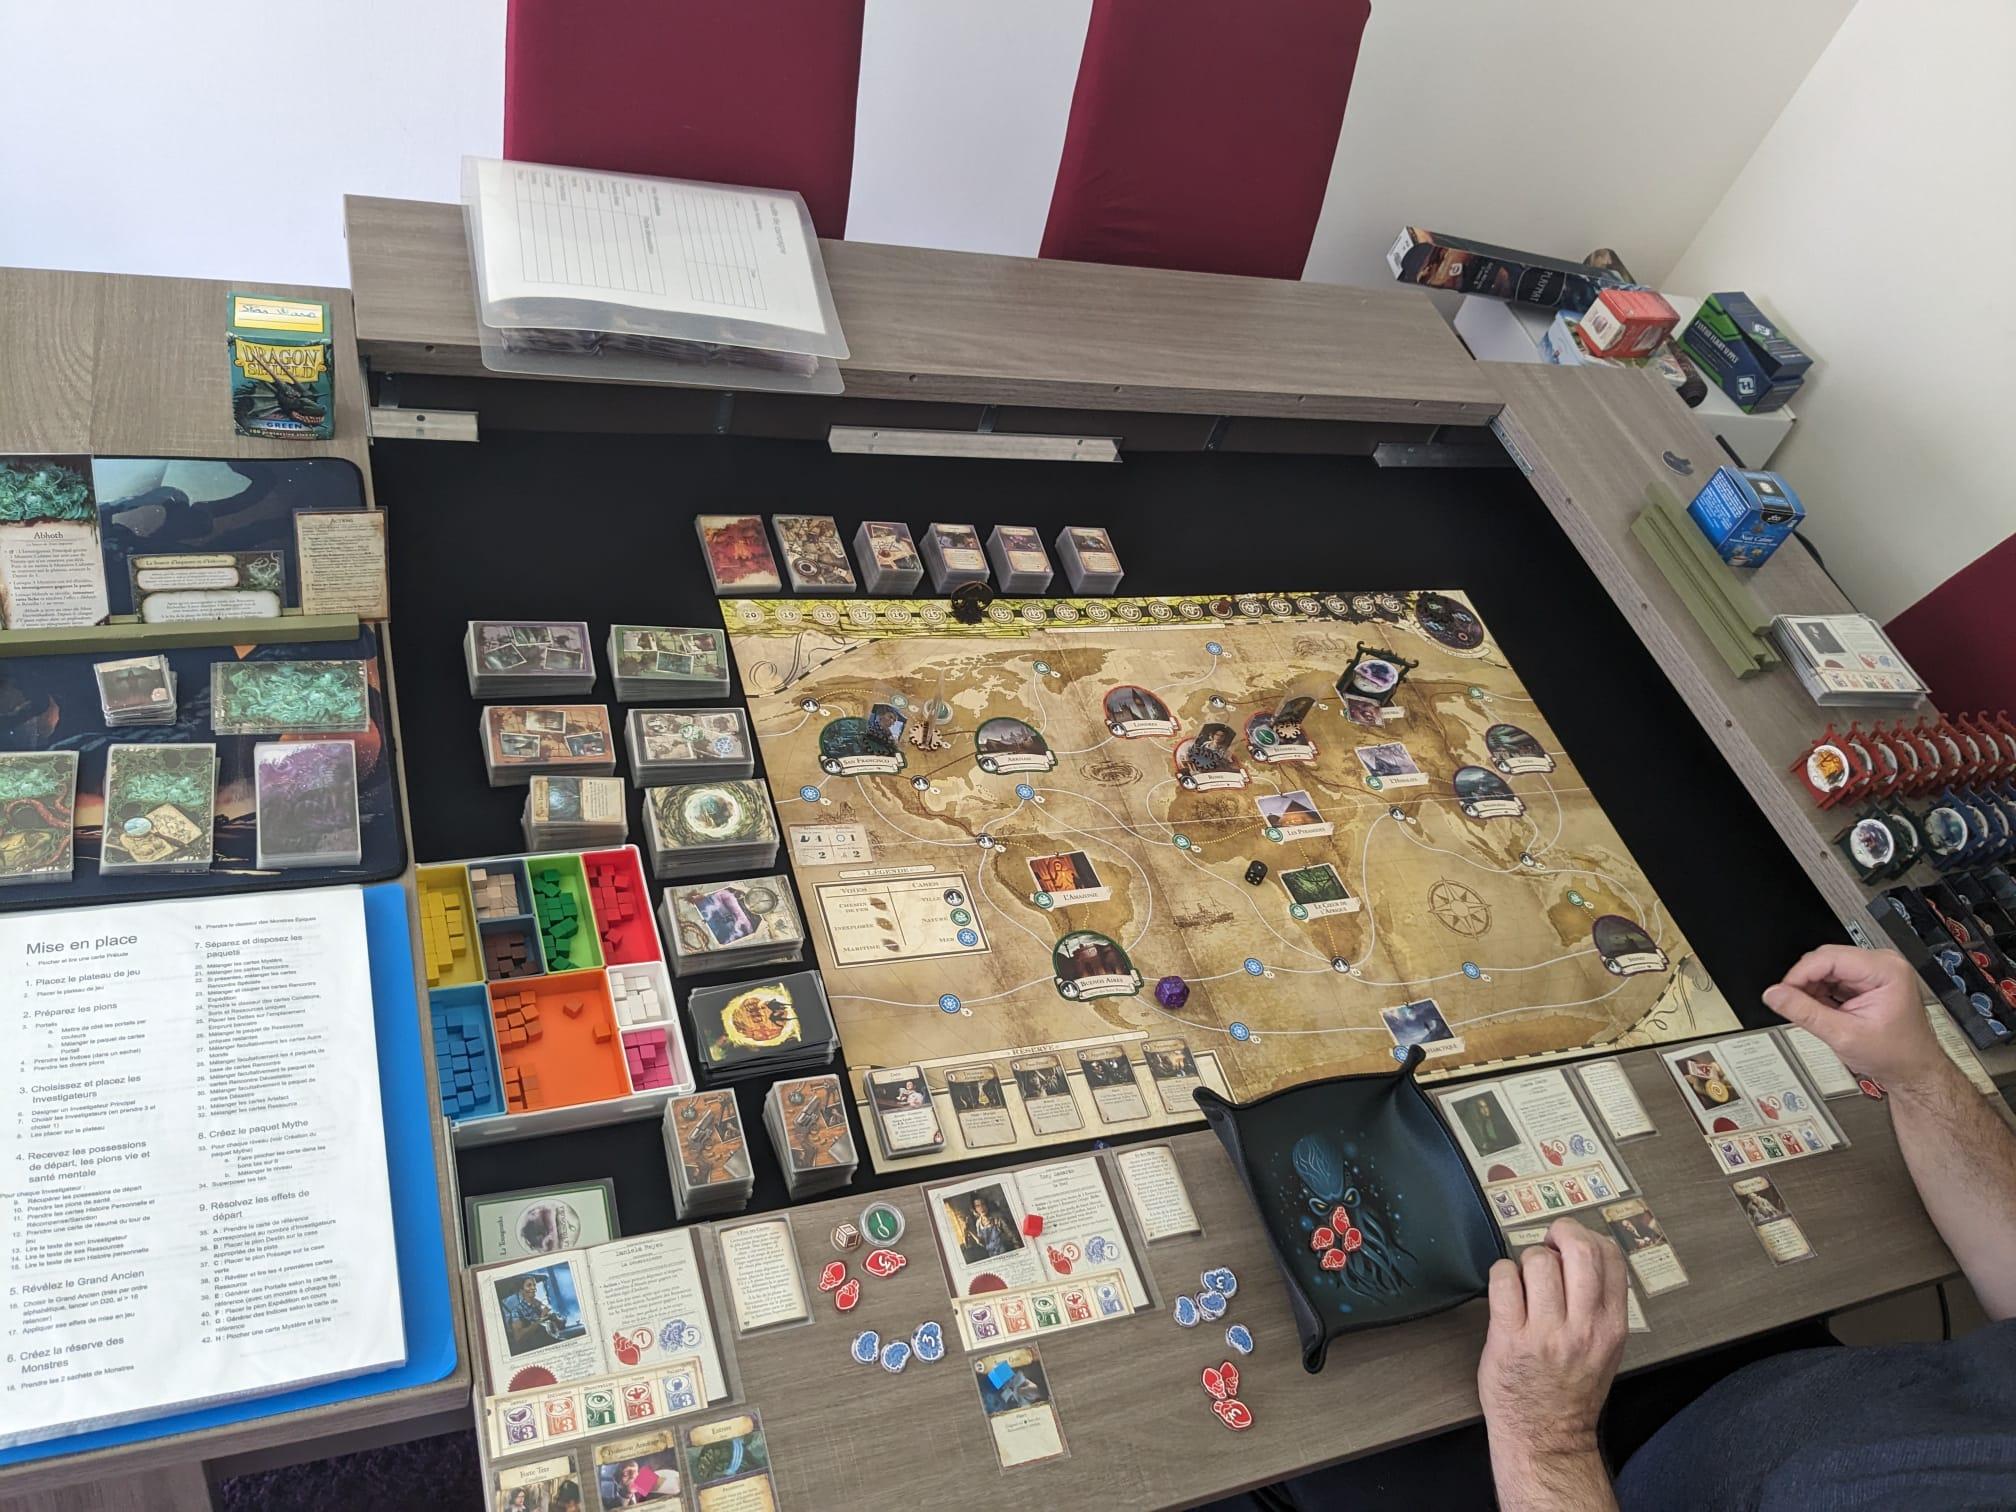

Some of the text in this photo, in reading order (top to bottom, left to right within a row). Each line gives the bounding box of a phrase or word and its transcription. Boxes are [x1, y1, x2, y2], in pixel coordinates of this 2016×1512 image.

[243, 345, 320, 367] DRAGON
[247, 363, 316, 379] SHIELD
[33, 531, 64, 540] Abhoth
[818, 850, 861, 859] 2 2
[26, 935, 137, 954] Mise en place
[204, 940, 240, 948] Séparez
[252, 936, 289, 944] disposez
[205, 949, 240, 959] paquets
[35, 977, 66, 986] Placez
[67, 975, 76, 983] le
[78, 972, 111, 983] plateau
[113, 969, 125, 977] de
[126, 968, 140, 978] jeu
[33, 1007, 75, 1017] Préparez
[77, 1005, 91, 1013] les
[93, 1003, 117, 1012] pions
[30, 1082, 82, 1093] Choisissez
[83, 1079, 93, 1087] et
[95, 1077, 125, 1087] placez
[32, 1091, 97, 1103] Investigateurs
[208, 1129, 236, 1138] Créez
[248, 1122, 279, 1134] paquet
[281, 1120, 308, 1129] Mythe
[27, 1150, 70, 1160] Recevez
[71, 1147, 86, 1155] les
[88, 1141, 146, 1154] possessions
[28, 1150, 150, 1171] de départ, les pions vie et
[28, 1168, 96, 1183] santé mentale
[210, 1198, 253, 1210] Résolvez
[255, 1195, 269, 1203] les
[270, 1191, 296, 1201] effets
[297, 1189, 309, 1198] de
[212, 1210, 242, 1221] départ
[1067, 1246, 1114, 1258] 5 7
[21, 1281, 63, 1293] Révélez
[65, 1279, 74, 1288] le
[77, 1274, 108, 1286] Grand
[110, 1270, 144, 1281] Ancien
[636, 1330, 696, 1345] 7 5
[19, 1349, 50, 1360] Créez
[53, 1346, 62, 1355] la
[65, 1340, 103, 1352] réserve
[105, 1337, 124, 1346] des
[20, 1359, 68, 1373] Monstres
[522, 1426, 534, 1440] 3
[562, 1417, 573, 1431] 3
[640, 1402, 652, 1416] 3
[680, 1394, 691, 1407] 3
